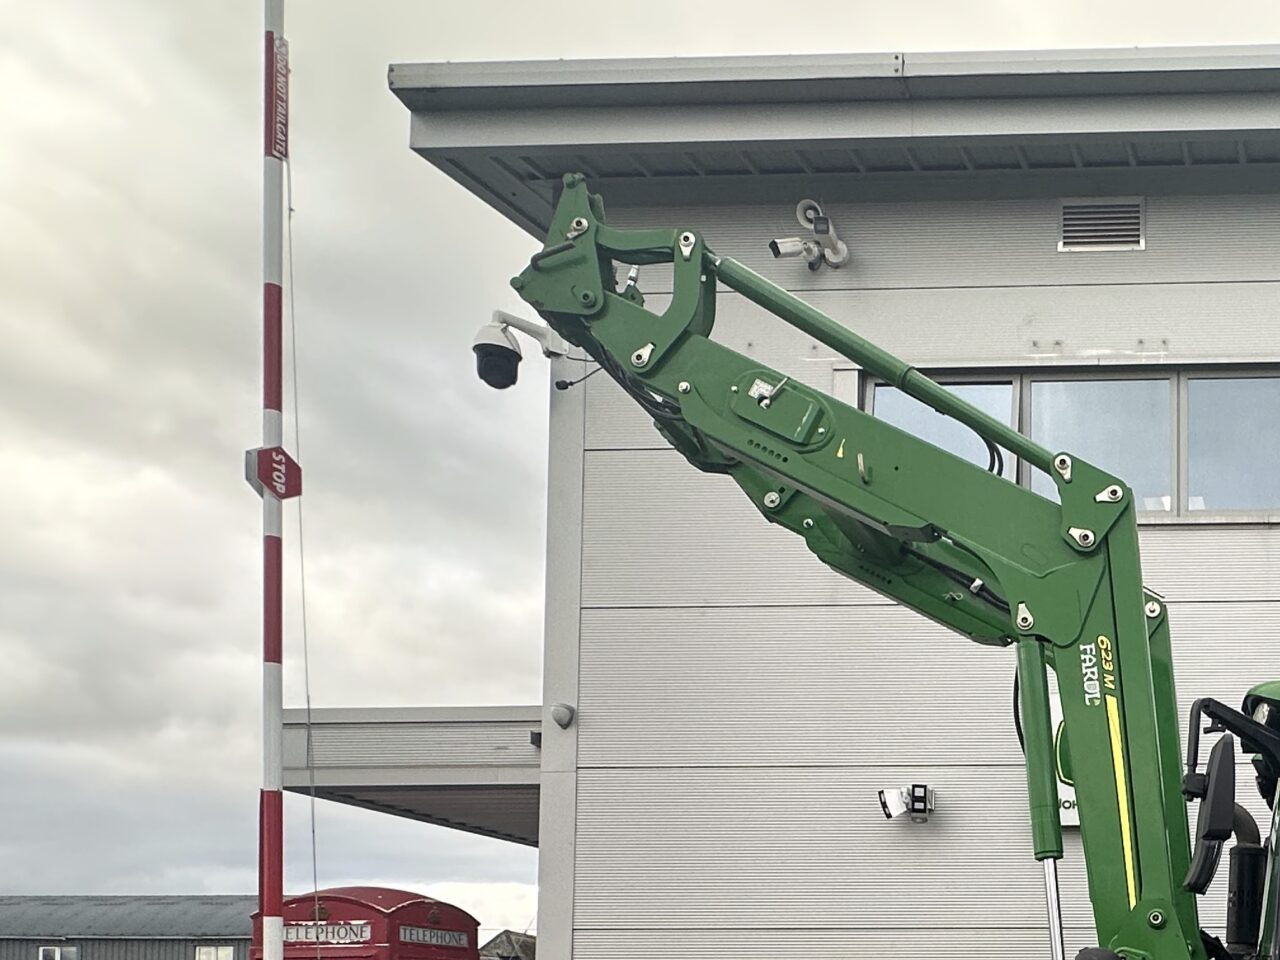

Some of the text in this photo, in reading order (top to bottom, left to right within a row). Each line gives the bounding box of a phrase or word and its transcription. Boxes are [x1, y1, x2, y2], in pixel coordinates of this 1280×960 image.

[276, 55, 287, 72] DO
[276, 73, 287, 98] NOT
[272, 451, 286, 494] STOP
[1097, 635, 1116, 690] 623 M
[284, 925, 368, 941] ELEPHONE
[401, 927, 465, 946] TELEPHONE
